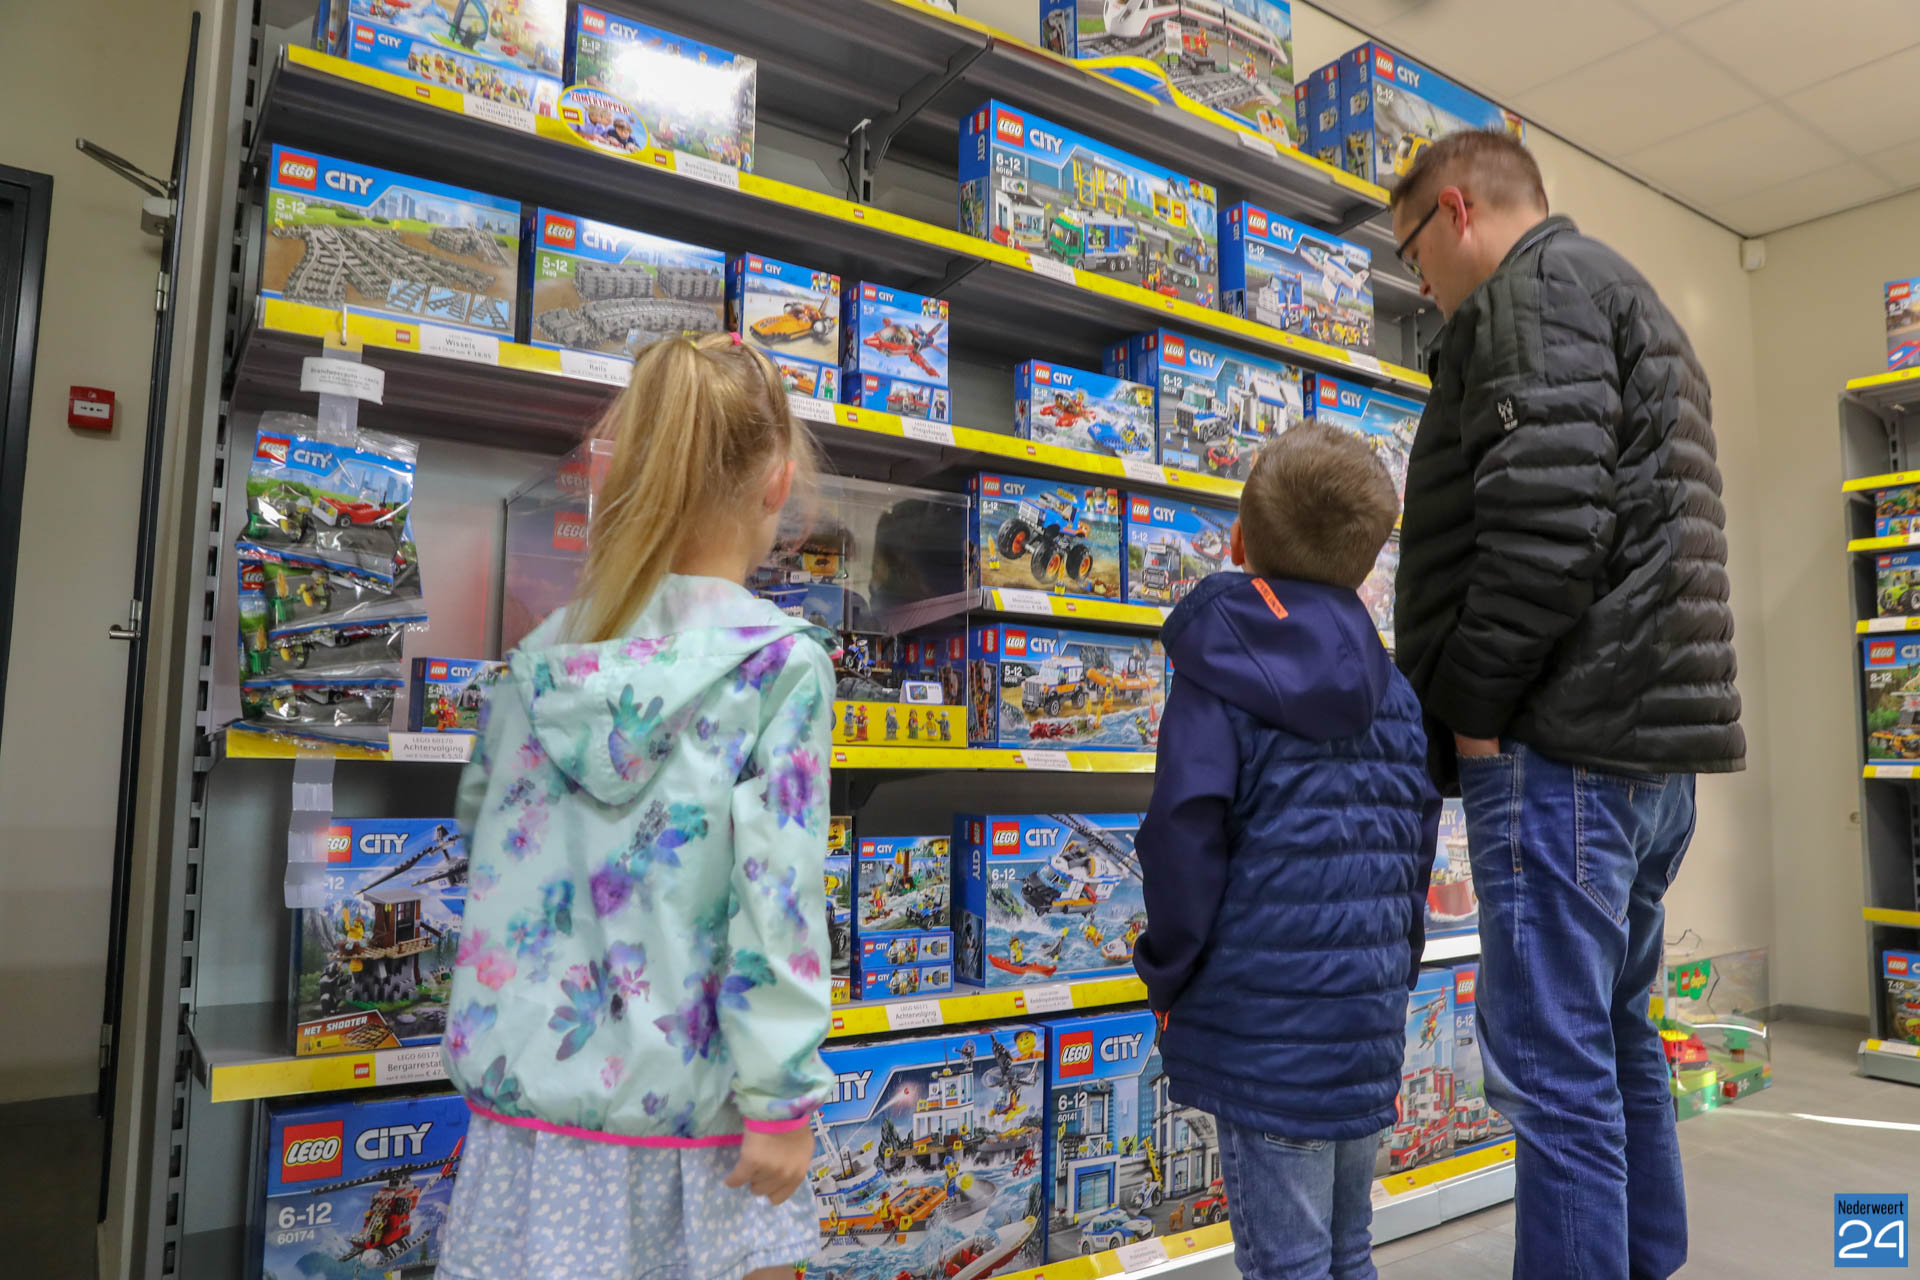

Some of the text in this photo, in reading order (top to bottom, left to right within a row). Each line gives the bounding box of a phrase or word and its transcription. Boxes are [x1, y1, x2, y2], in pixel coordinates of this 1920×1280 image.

[583, 15, 638, 40] LEGO CITY
[377, 33, 401, 49] CITY
[1376, 57, 1420, 89] LEGO CITY
[999, 119, 1022, 137] LEGO
[1029, 128, 1064, 155] CITY
[996, 152, 1021, 171] 6-12
[281, 162, 374, 195] LEGO CITY
[276, 197, 306, 216] 5-12
[1249, 215, 1295, 242] LEGO CITY
[547, 223, 620, 253] LEGO CITY
[542, 256, 568, 273] 5-12
[765, 264, 782, 275] CITY
[878, 291, 895, 302] CITY
[1165, 342, 1216, 368] LEGO CITY
[1053, 372, 1073, 386] CITY
[1163, 374, 1183, 387] 6-12
[1320, 388, 1363, 408] LEGO CITY
[293, 448, 333, 469] CITY
[984, 480, 1026, 495] LEGO CITY
[1133, 504, 1176, 523] LEGO CITY
[1131, 531, 1148, 541] 5-12
[1006, 637, 1057, 653] LEGO CITY
[1871, 647, 1894, 658] LEGO
[450, 667, 472, 677] CITY
[1004, 665, 1023, 676] 5-12
[403, 744, 464, 754] Achtervolging
[359, 833, 410, 854] CITY
[994, 827, 1060, 847] LEGO CITY
[877, 843, 893, 853] CITY
[972, 849, 981, 880] CITY
[991, 868, 1016, 881] 6-12
[875, 942, 888, 950] CITY
[878, 973, 890, 981] CITY
[1458, 980, 1474, 993] LEGO
[304, 1016, 368, 1036] NET SHOOTER
[1456, 1013, 1474, 1028] 6-12
[1062, 1032, 1144, 1064] LEGO CITY
[1058, 1091, 1088, 1111] 6-12
[1057, 1111, 1077, 1123] 60141
[286, 1121, 434, 1166] LEGO CITY
[278, 1202, 333, 1229] 6-12
[277, 1228, 316, 1245] 60174
